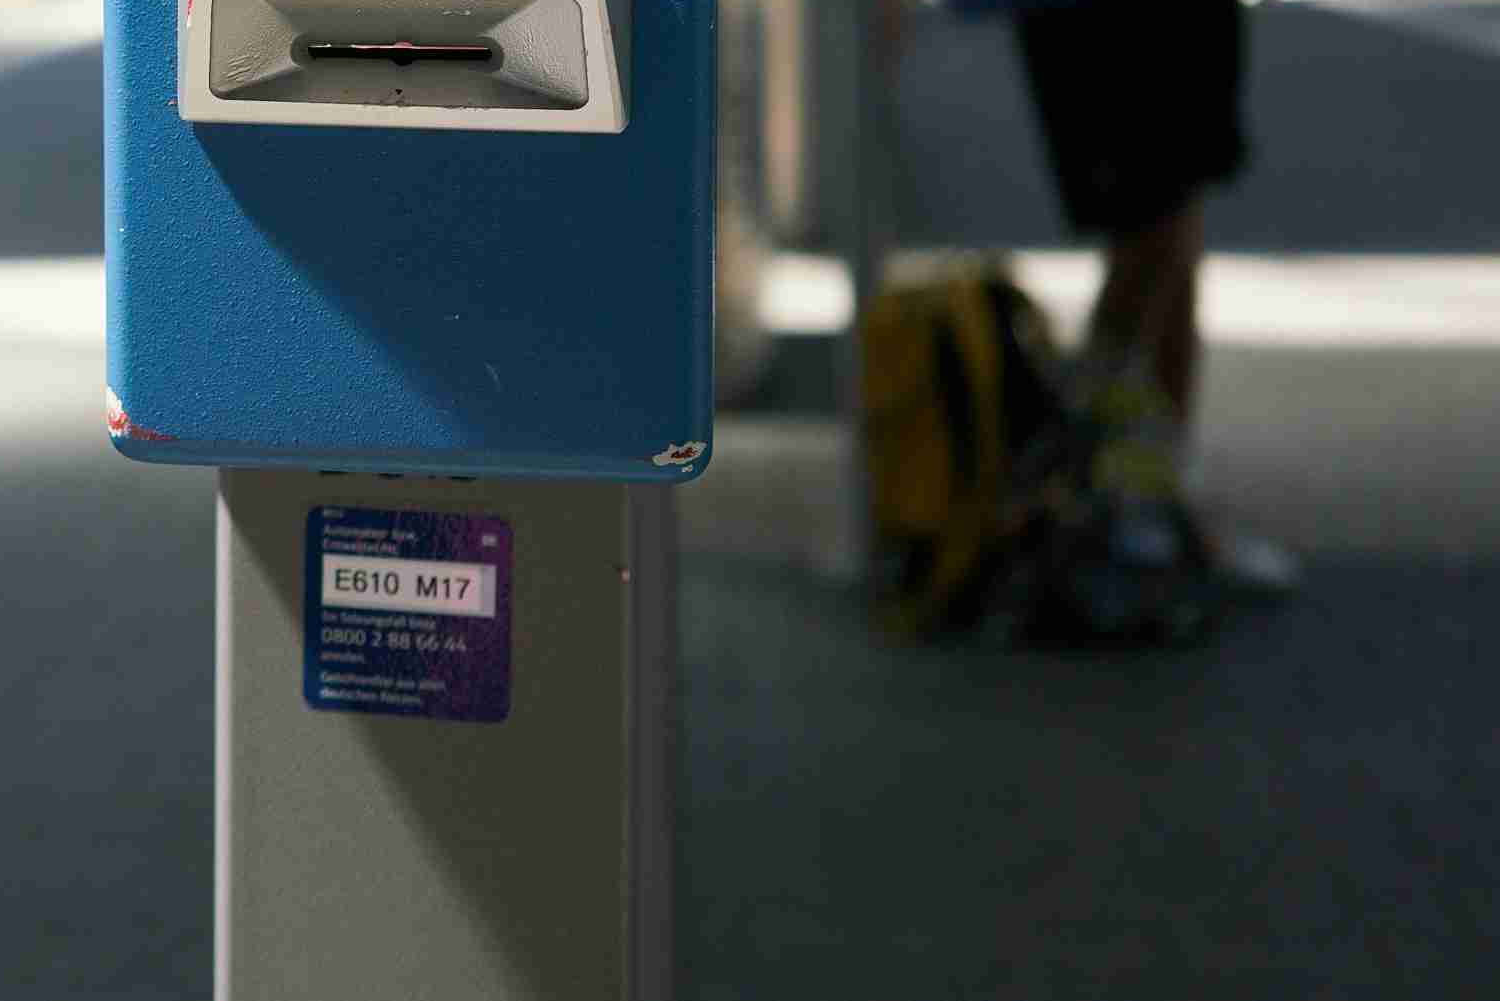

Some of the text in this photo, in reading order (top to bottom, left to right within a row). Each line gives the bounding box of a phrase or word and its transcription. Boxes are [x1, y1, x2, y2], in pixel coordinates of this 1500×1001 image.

[334, 568, 471, 600] E610 M17
[321, 628, 366, 646] 0800
[372, 631, 382, 648] 2
[387, 632, 411, 650] 88
